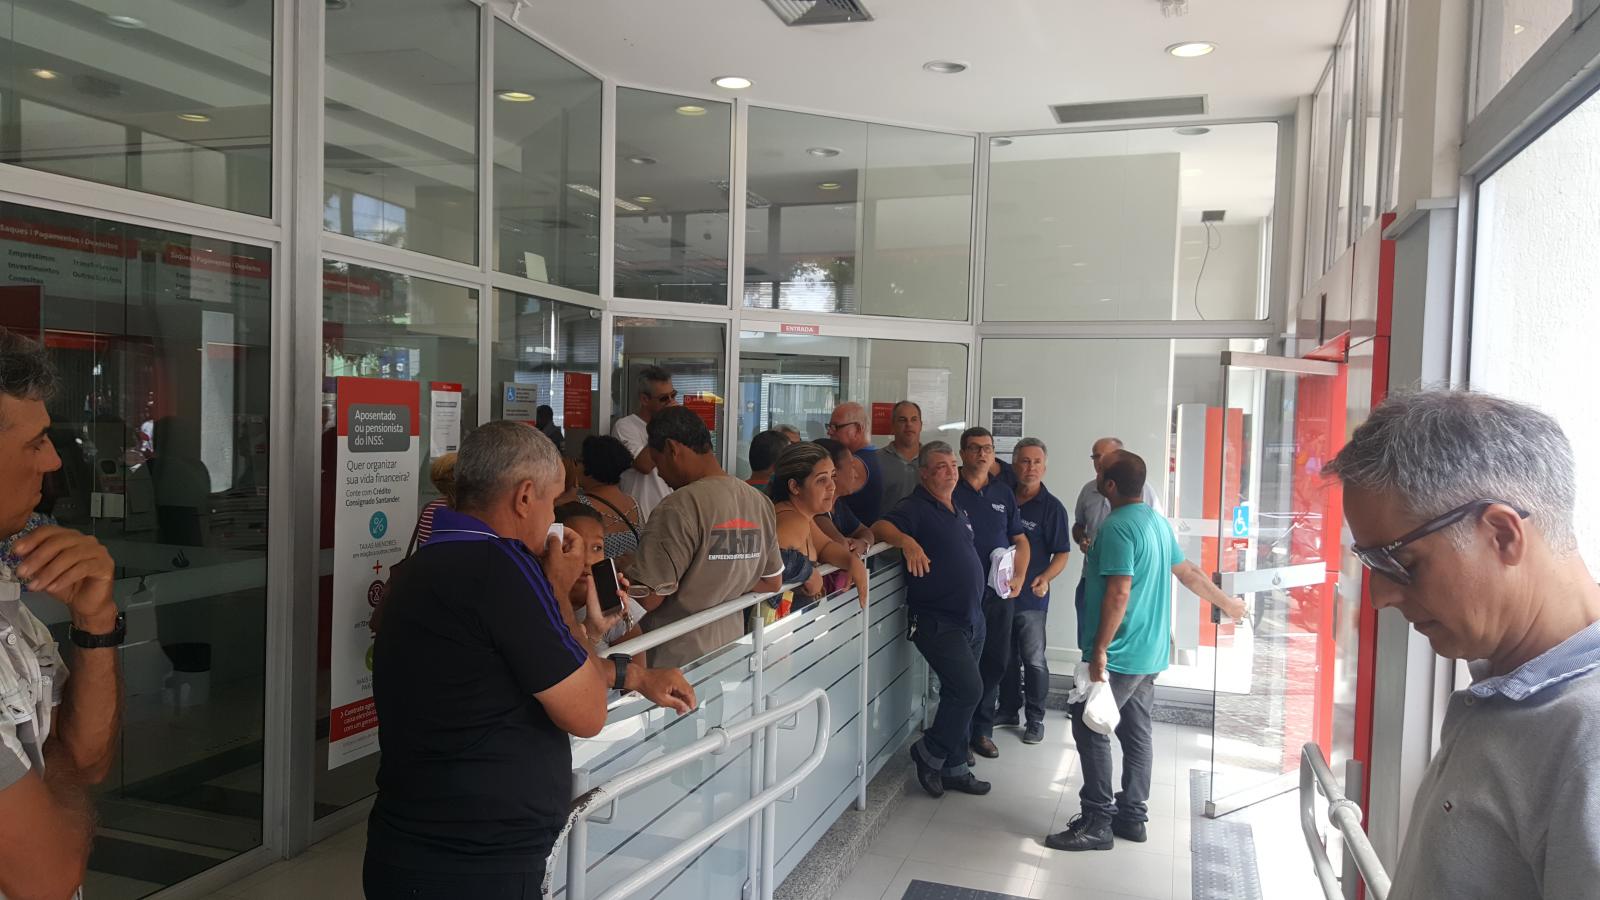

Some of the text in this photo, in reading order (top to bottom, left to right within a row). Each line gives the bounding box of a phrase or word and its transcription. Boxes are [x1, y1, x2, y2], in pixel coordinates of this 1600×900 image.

[785, 325, 814, 333] ENTRADA
[354, 410, 396, 422] Aposentado
[354, 422, 404, 434] ou pensionista
[354, 435, 384, 446] do INSS:
[346, 460, 397, 472] Quer organizar
[346, 472, 410, 485] sua vida financeira?
[373, 487, 391, 496] Crédito
[346, 497, 375, 507] Consignado
